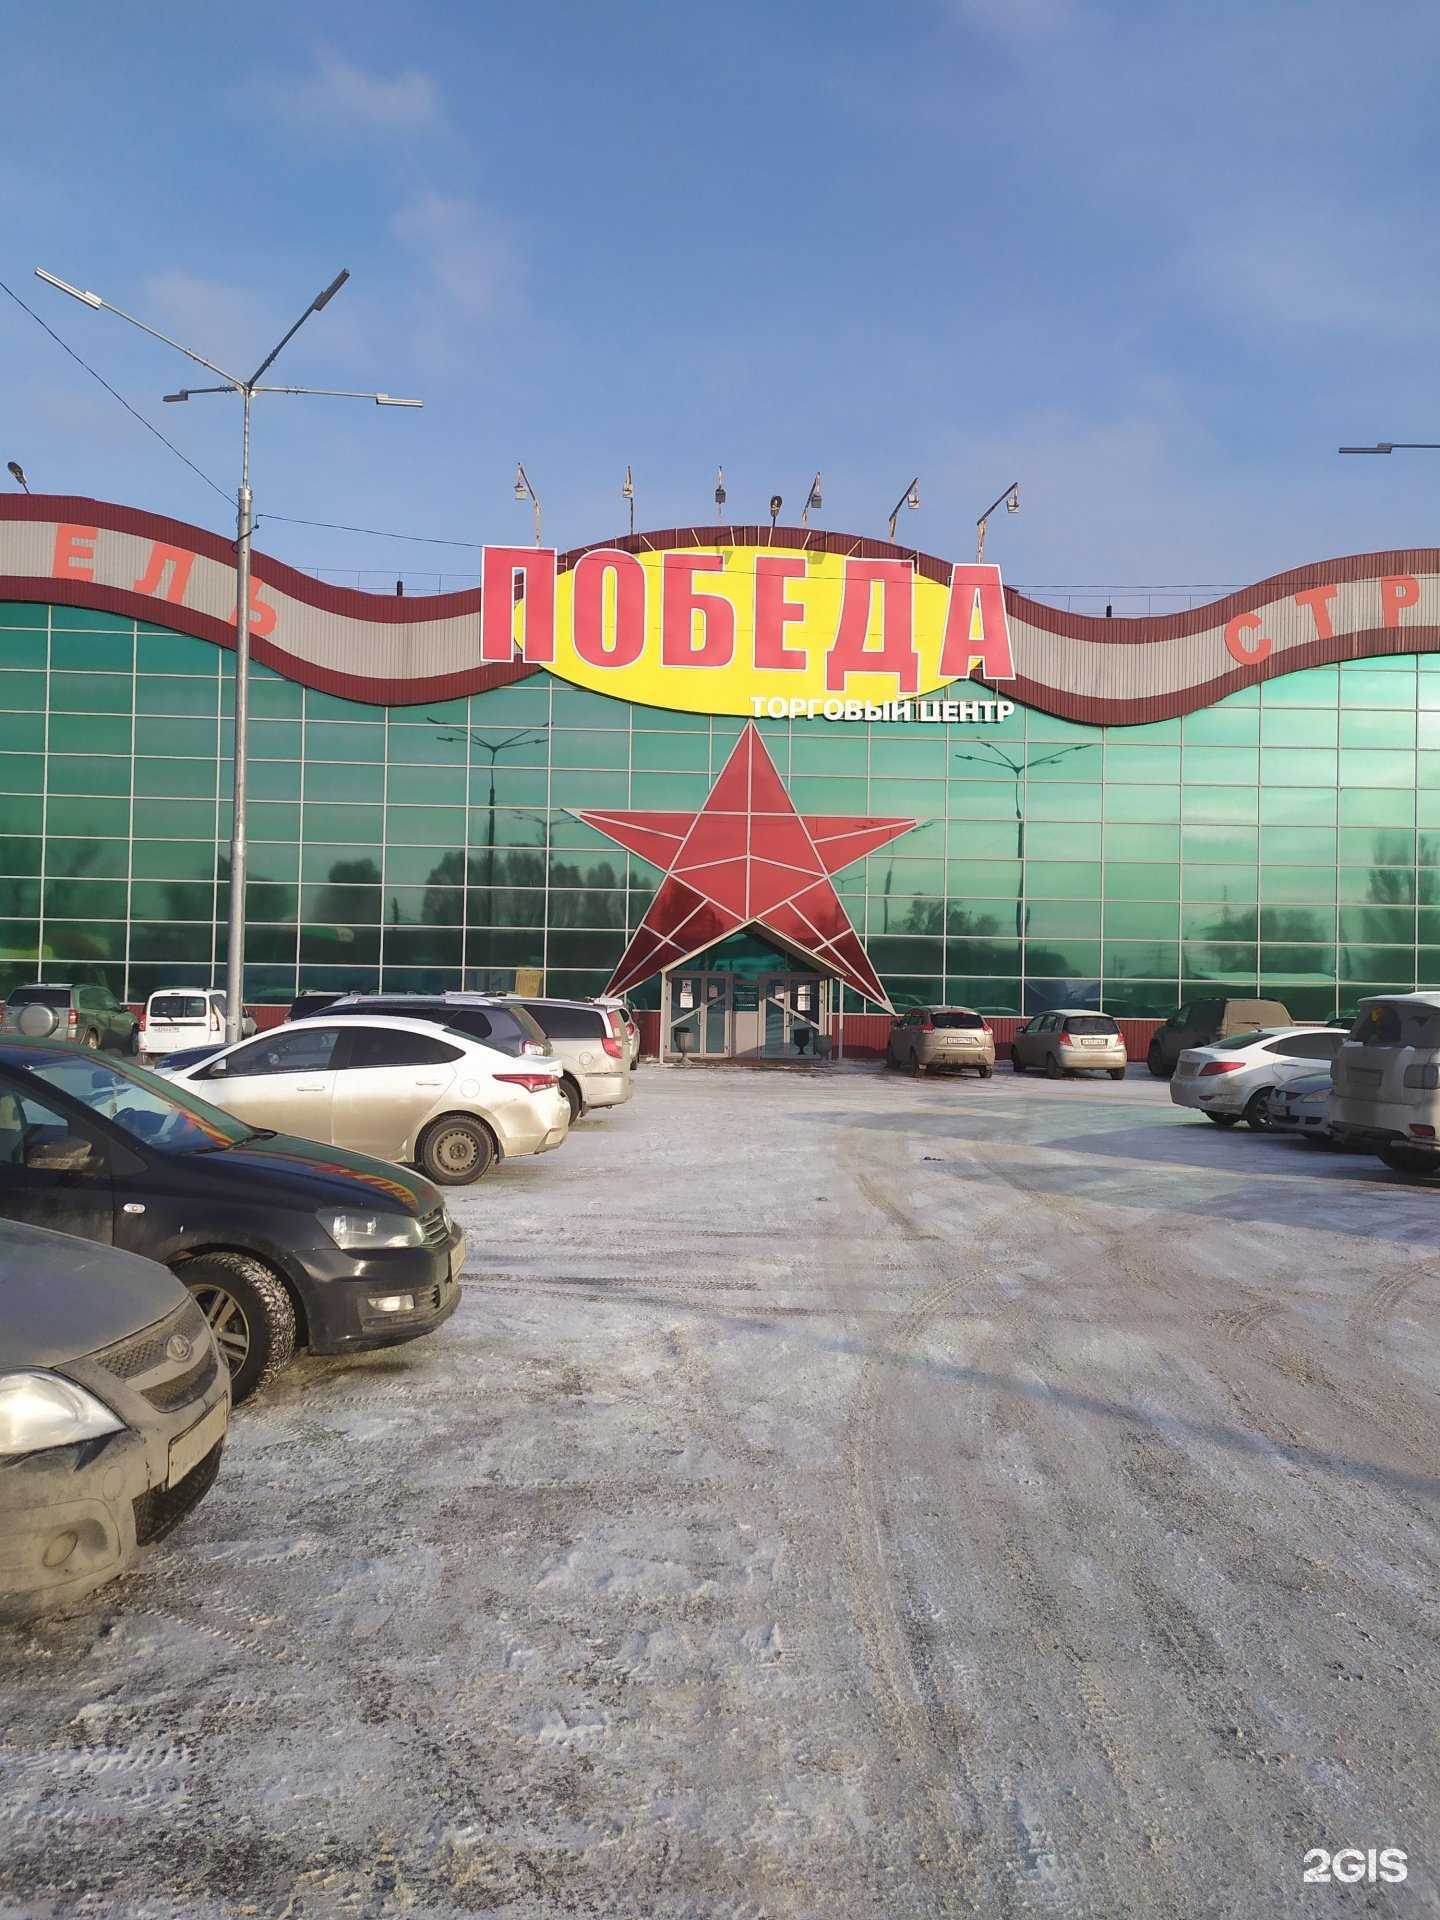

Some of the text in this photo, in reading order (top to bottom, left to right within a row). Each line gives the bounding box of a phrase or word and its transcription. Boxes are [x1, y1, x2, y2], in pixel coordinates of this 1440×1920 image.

[480, 545, 1016, 695] ПОБЕДА
[1224, 575, 1420, 666] СТР
[750, 695, 1016, 723] ТОРГОВЫЙ ЦЕНТР
